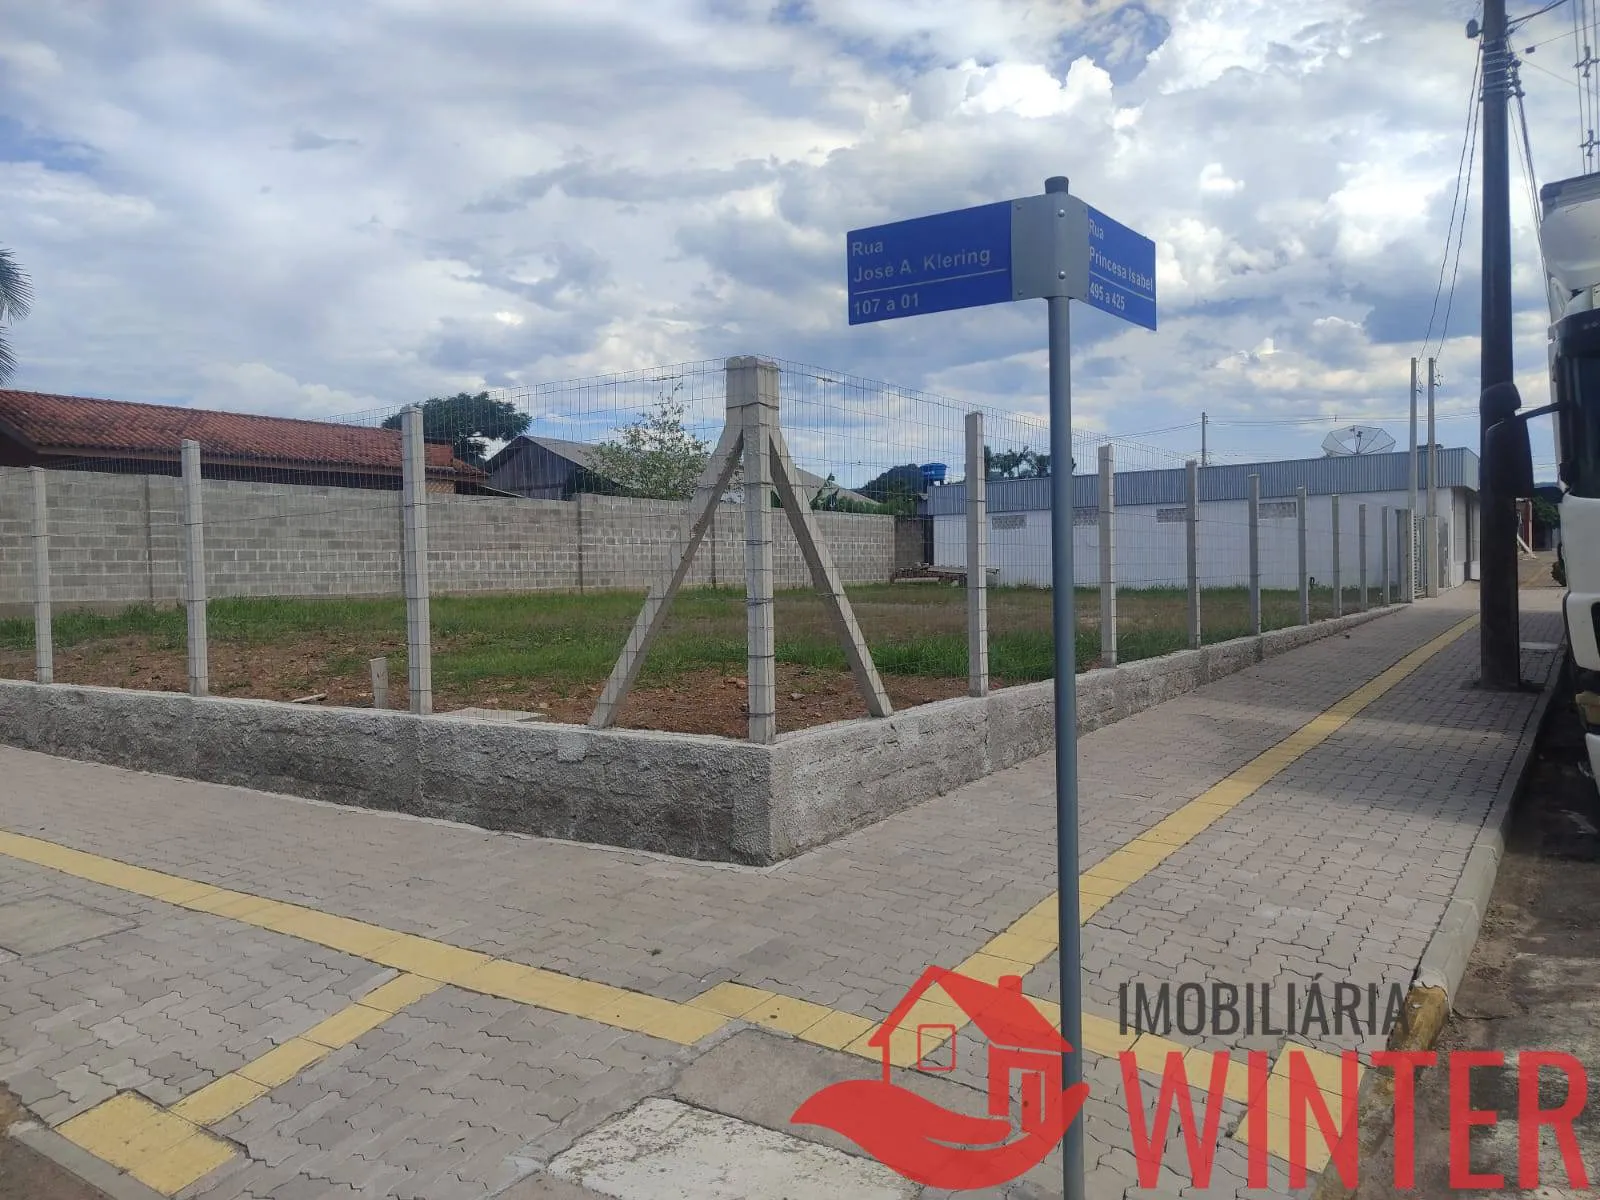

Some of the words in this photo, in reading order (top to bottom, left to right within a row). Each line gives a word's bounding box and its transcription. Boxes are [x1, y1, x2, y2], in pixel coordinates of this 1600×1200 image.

[1089, 218, 1104, 240] Rua
[852, 241, 883, 256] Rua
[923, 248, 990, 271] Klering
[1089, 246, 1126, 279] Princesa
[1128, 266, 1153, 292] Isabel
[854, 299, 880, 315] 107
[886, 301, 895, 312] a
[901, 292, 919, 308] 01
[1089, 282, 1104, 301] 495
[1105, 292, 1110, 304] a
[1111, 292, 1125, 311] 425
